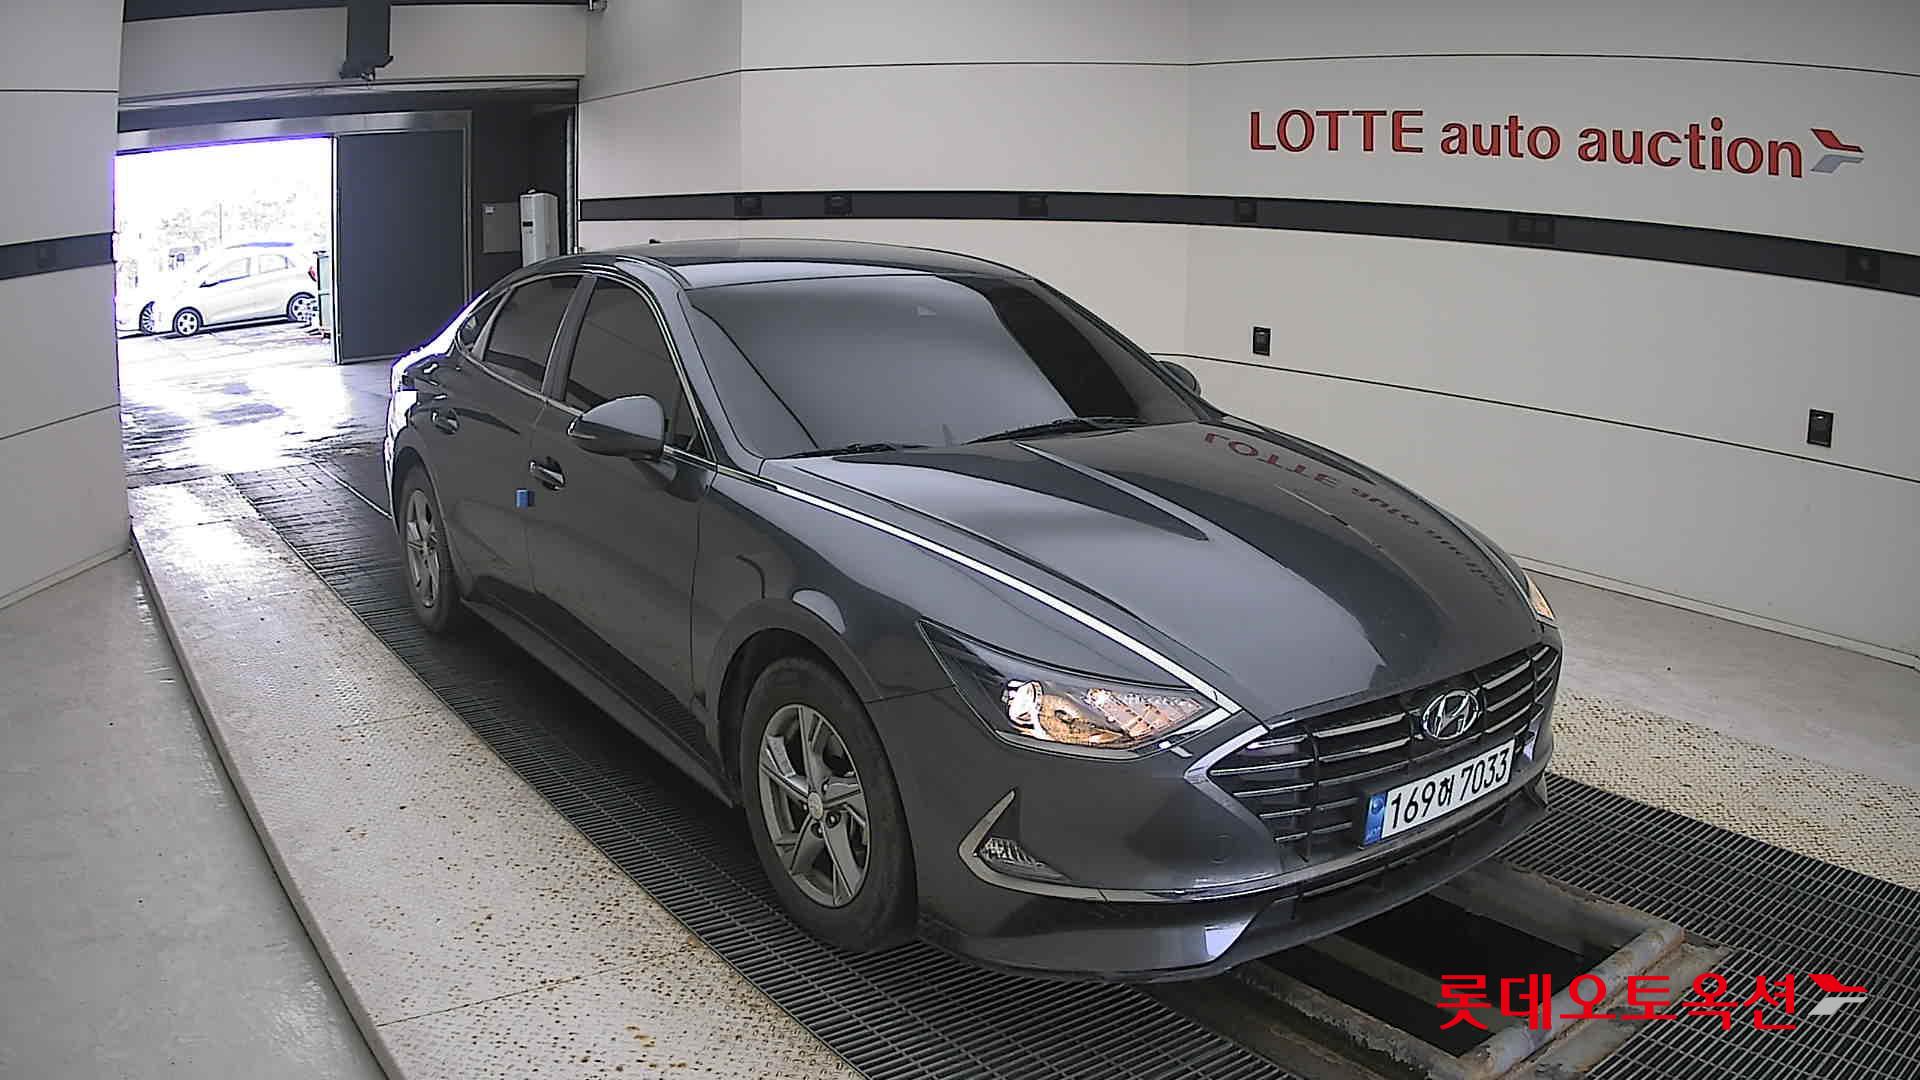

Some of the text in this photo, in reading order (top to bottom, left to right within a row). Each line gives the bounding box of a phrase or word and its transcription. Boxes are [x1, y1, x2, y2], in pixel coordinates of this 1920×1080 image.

[1249, 109, 1804, 179] LOTTE auto auction
[1390, 746, 1511, 830] 169허 7033
